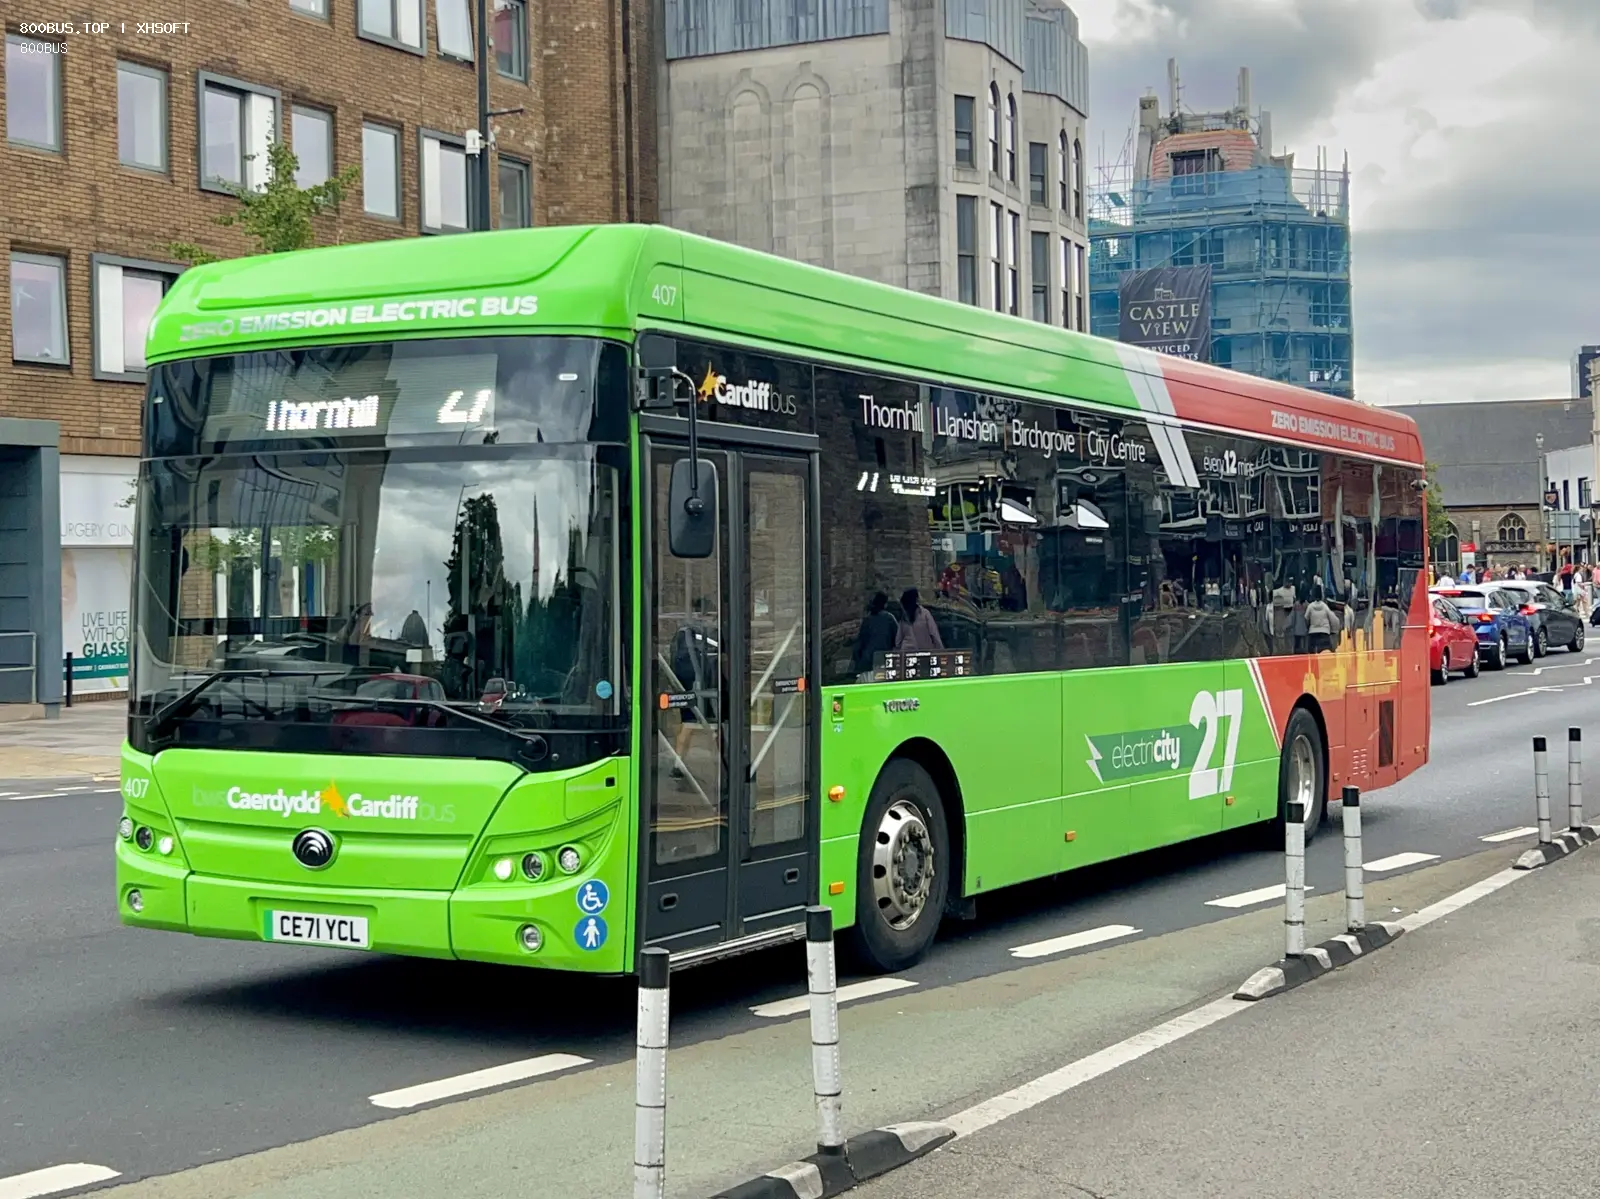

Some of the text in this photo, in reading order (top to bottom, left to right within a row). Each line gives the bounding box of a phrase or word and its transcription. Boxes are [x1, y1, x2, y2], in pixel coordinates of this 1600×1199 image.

[651, 284, 677, 306] 407
[238, 307, 347, 334] EMISSION
[350, 297, 477, 323] ELECTRIC
[480, 295, 538, 316] BUS
[1129, 303, 1199, 321] CASTLE
[859, 395, 1146, 466] Thornhill Llanishen Birchgrove City Centre
[1271, 410, 1298, 432] ZERO
[1224, 450, 1237, 474] 12
[82, 610, 127, 627] LIVE LIFE
[1111, 688, 1243, 800] electricity 27
[123, 778, 149, 799] 407
[280, 916, 361, 943] CE71 YCL
